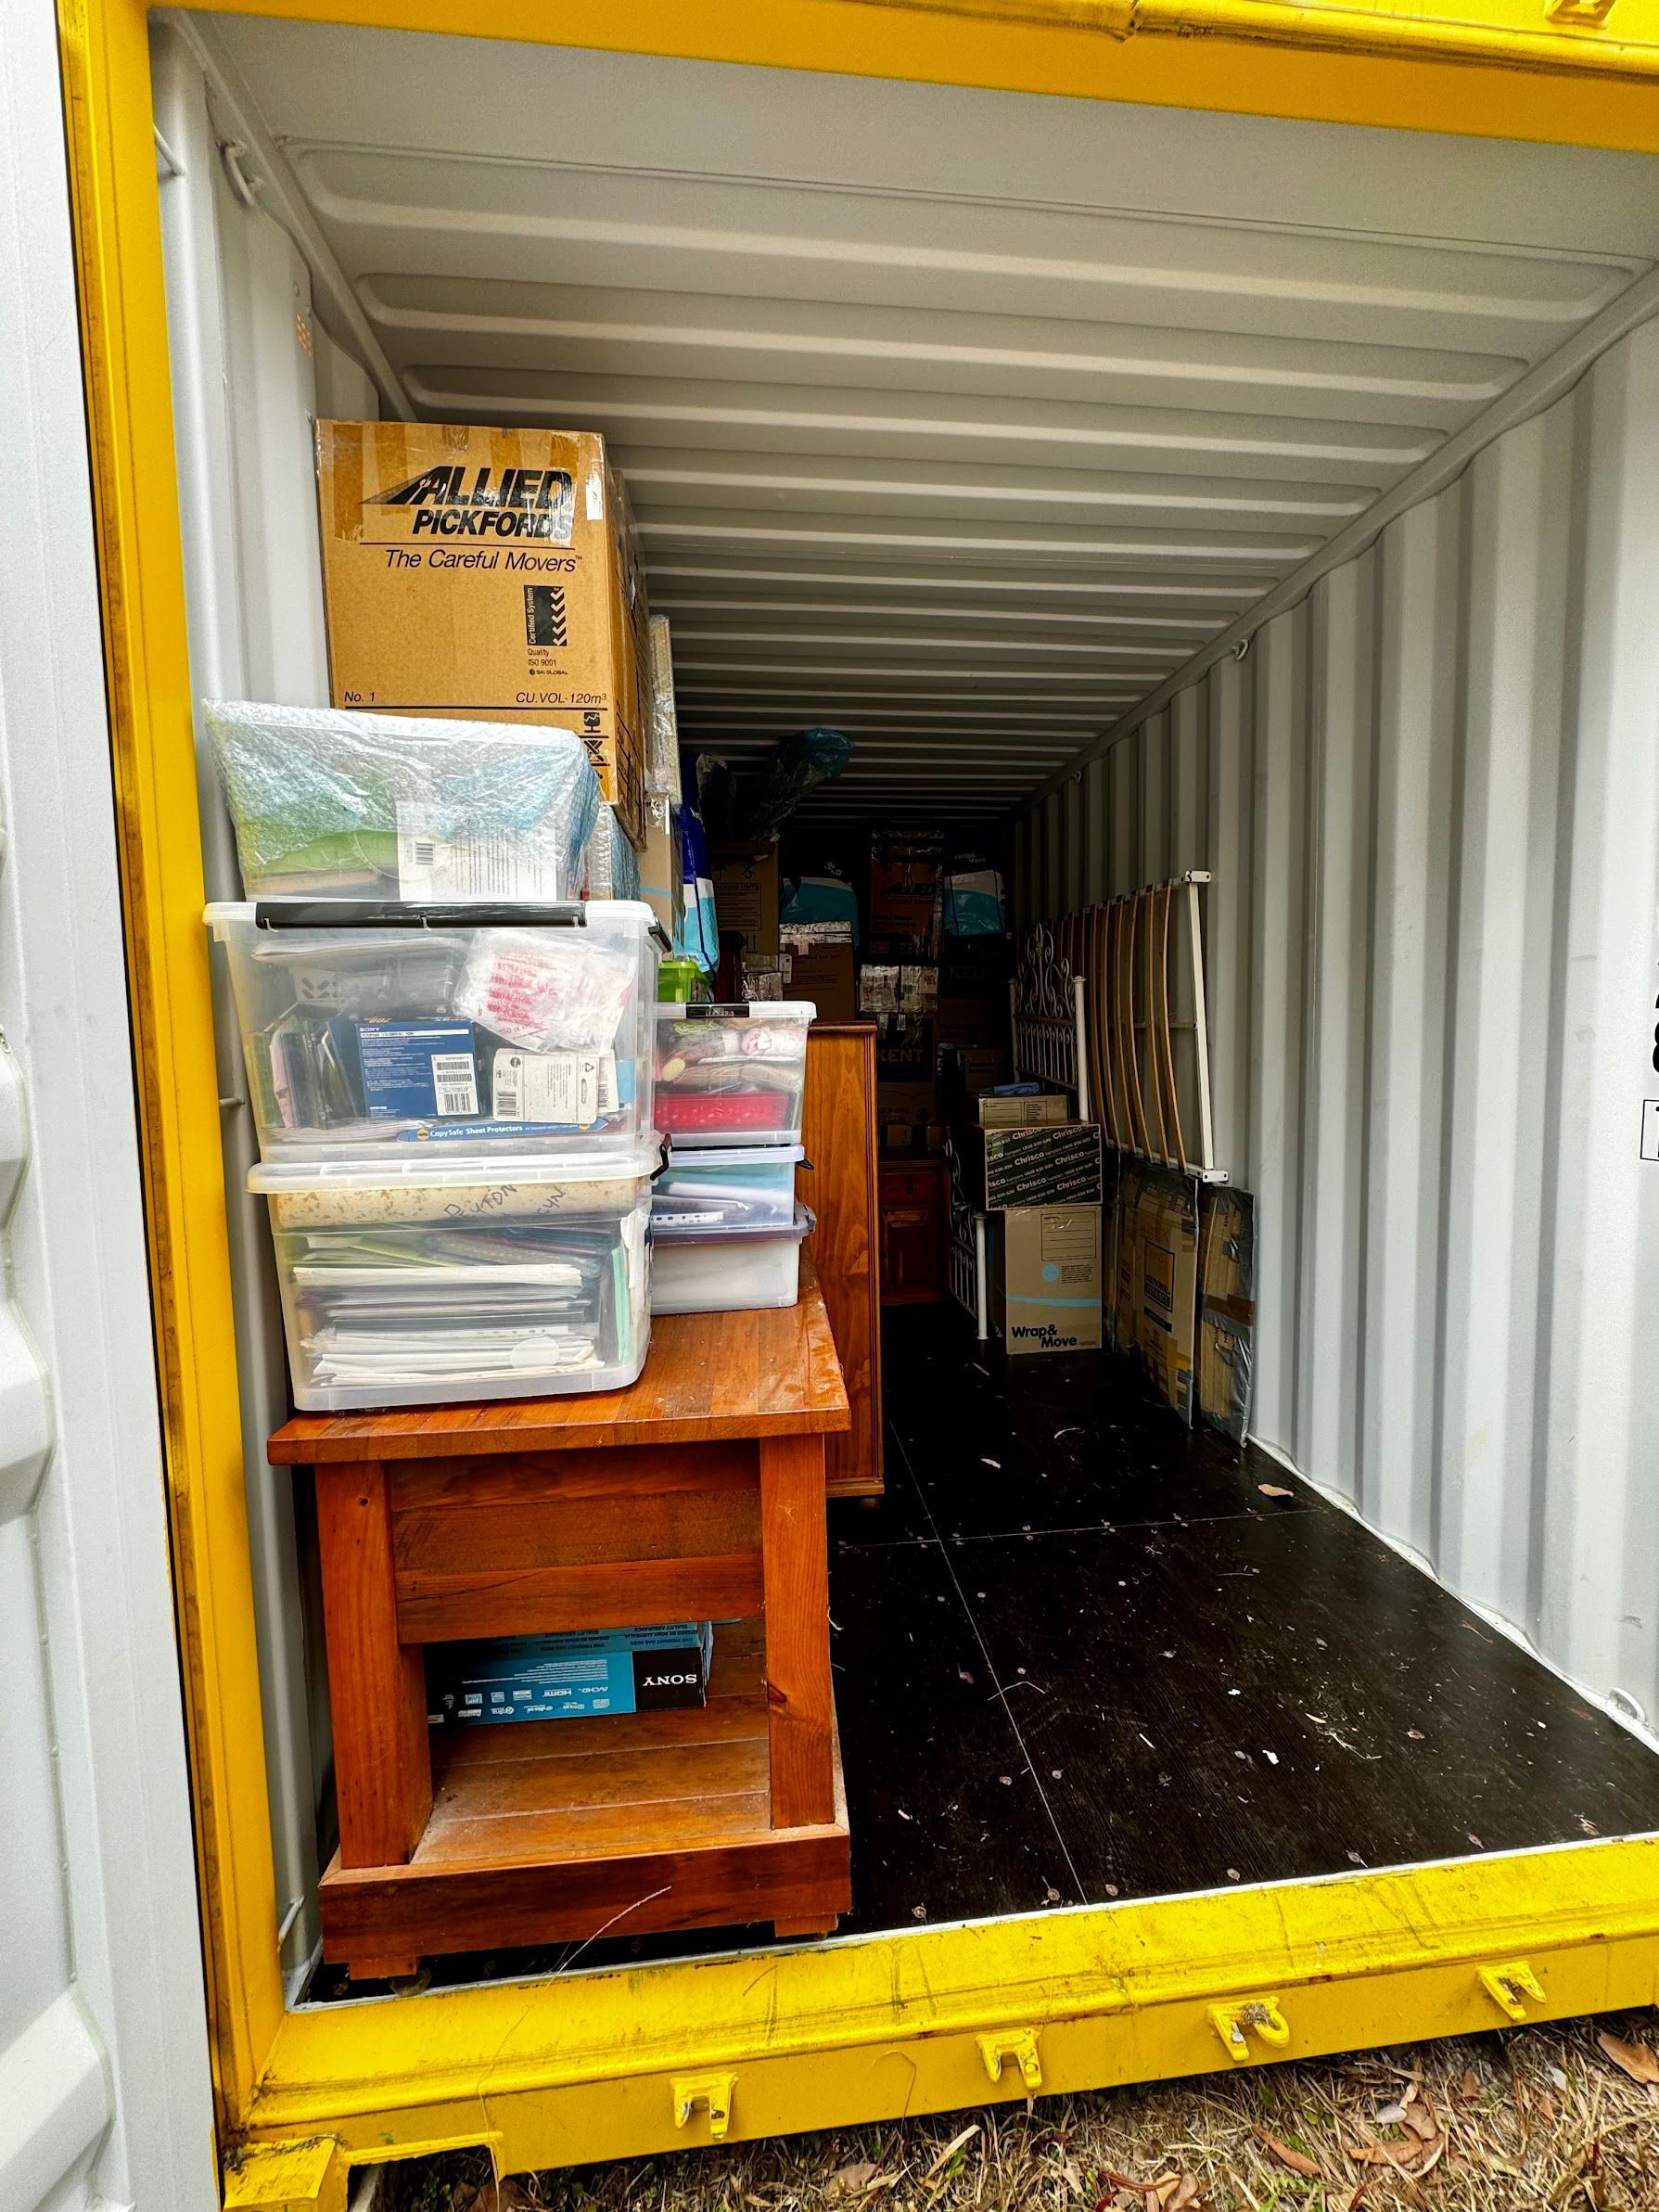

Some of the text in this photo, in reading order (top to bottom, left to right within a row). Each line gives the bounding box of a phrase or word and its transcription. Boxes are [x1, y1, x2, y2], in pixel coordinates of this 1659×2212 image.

[408, 466, 573, 509] ALLIED
[412, 508, 572, 540] PICKFORDS
[385, 549, 422, 568] The
[428, 549, 500, 569] Careful
[527, 587, 537, 645] Certified System
[527, 648, 549, 657] Quality
[344, 691, 376, 702] No. 1
[486, 1124, 523, 1134] Protectors
[1053, 1126, 1083, 1139] Chrisco
[1014, 1151, 1045, 1165] Chrisco
[1055, 1151, 1085, 1165] Chrisco
[1016, 1177, 1047, 1191] Chrisco
[1057, 1177, 1086, 1191] Chrisco
[1011, 1323, 1058, 1339] Wrap&
[1040, 1335, 1078, 1348] Move
[642, 1673, 697, 1687] SONY
[543, 1688, 572, 1697] HDMI
